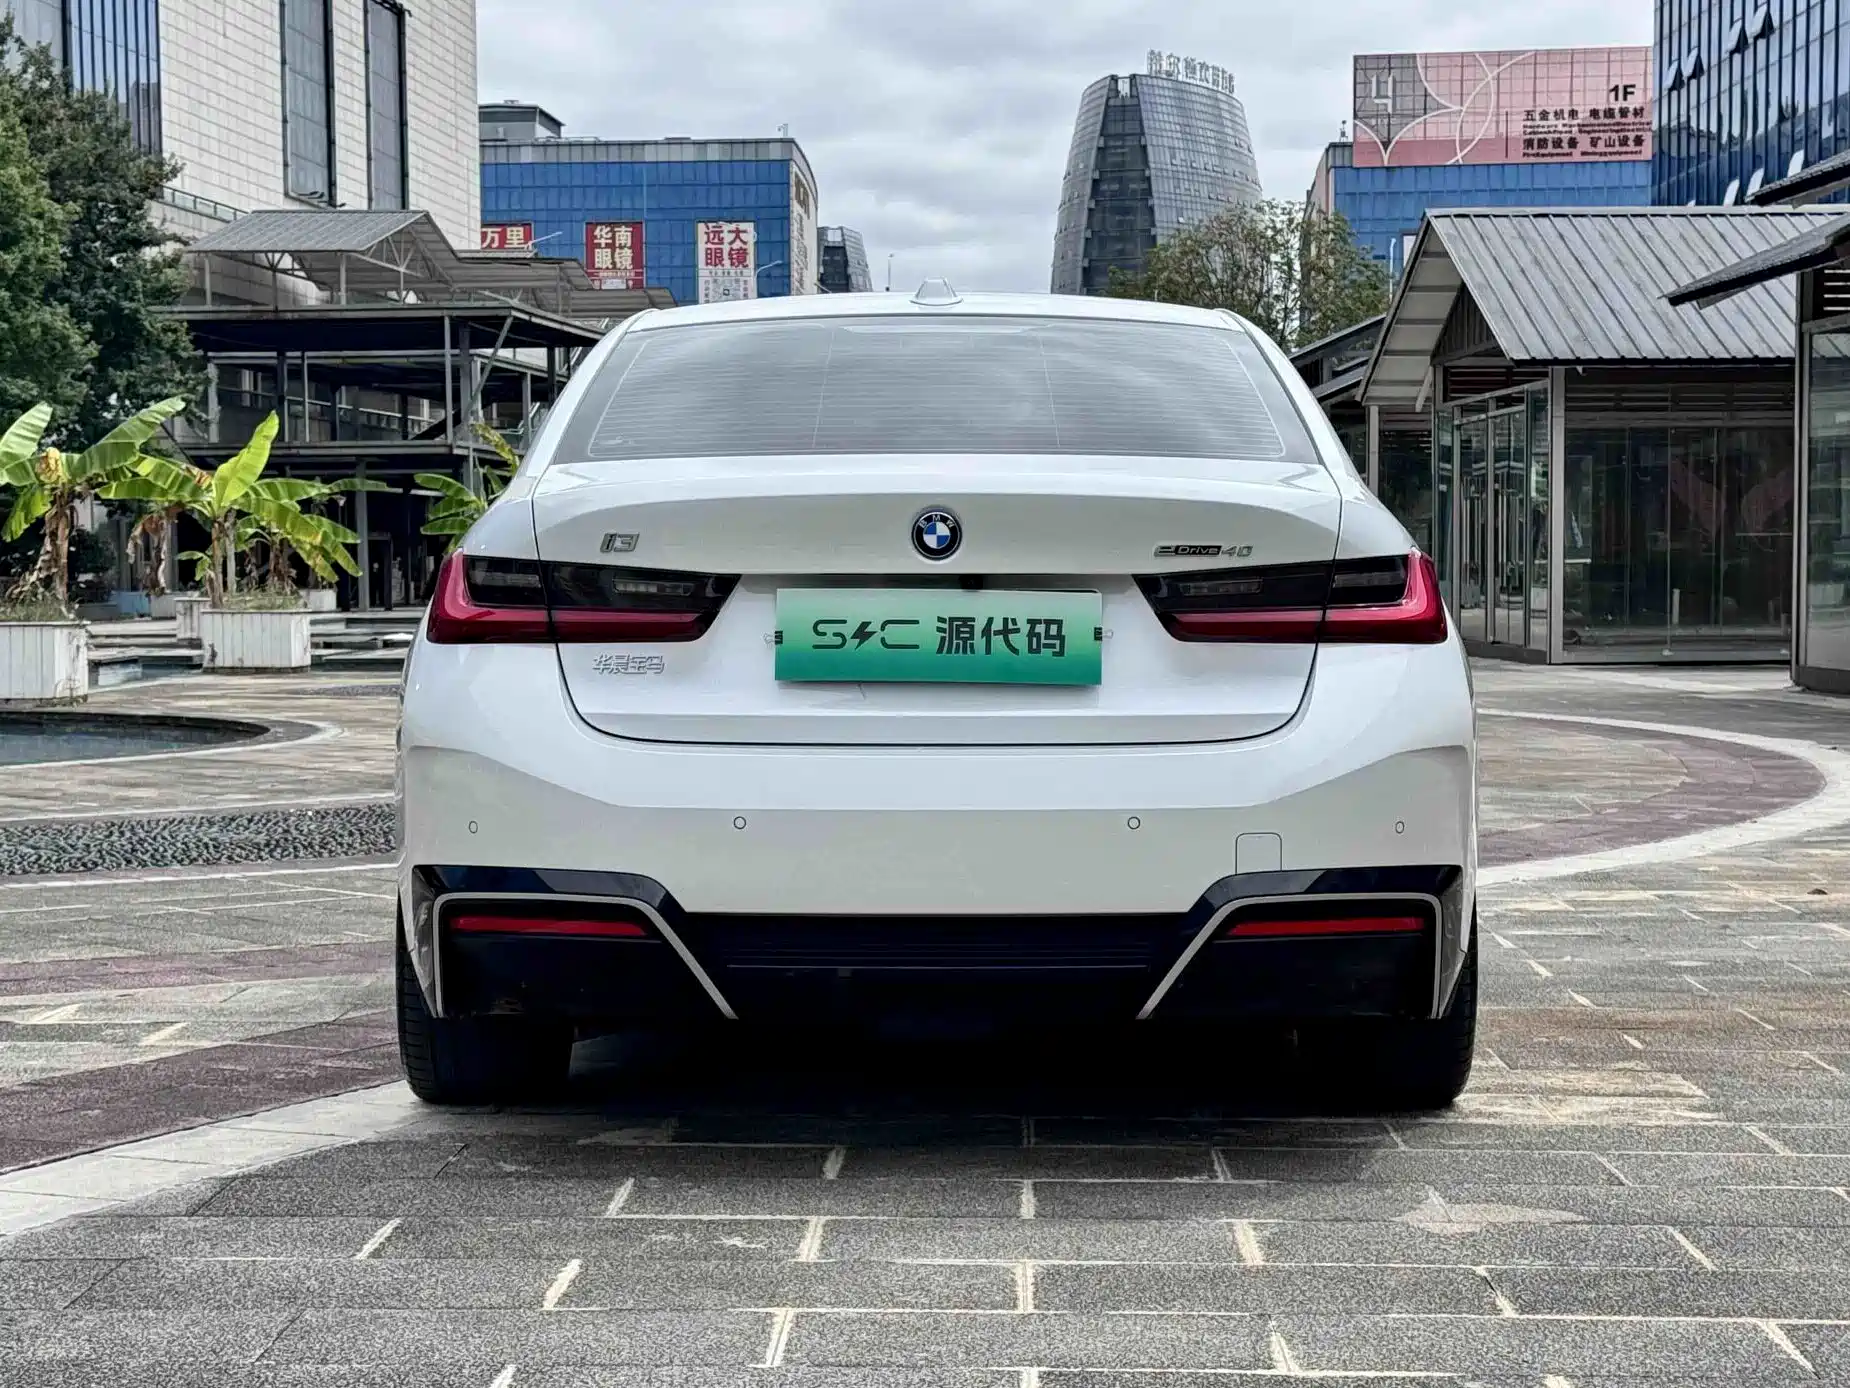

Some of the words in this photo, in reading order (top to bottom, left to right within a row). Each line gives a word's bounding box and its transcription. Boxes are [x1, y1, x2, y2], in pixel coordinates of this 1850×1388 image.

[1609, 84, 1636, 101] 1F
[1523, 108, 1579, 121] 五金机电
[1589, 106, 1645, 119] 电缆管材
[1523, 136, 1579, 150] 消防设备
[1589, 134, 1645, 148] 矿山设备
[481, 226, 526, 248] 万里
[593, 225, 633, 247] 华南
[704, 222, 749, 246] 远大
[594, 248, 634, 269] 眼镜
[704, 247, 749, 268] 眼镜
[918, 514, 955, 529] BMW
[600, 532, 640, 552] i3
[935, 616, 1066, 657] 源代码
[592, 654, 666, 675] 华晨宝马
